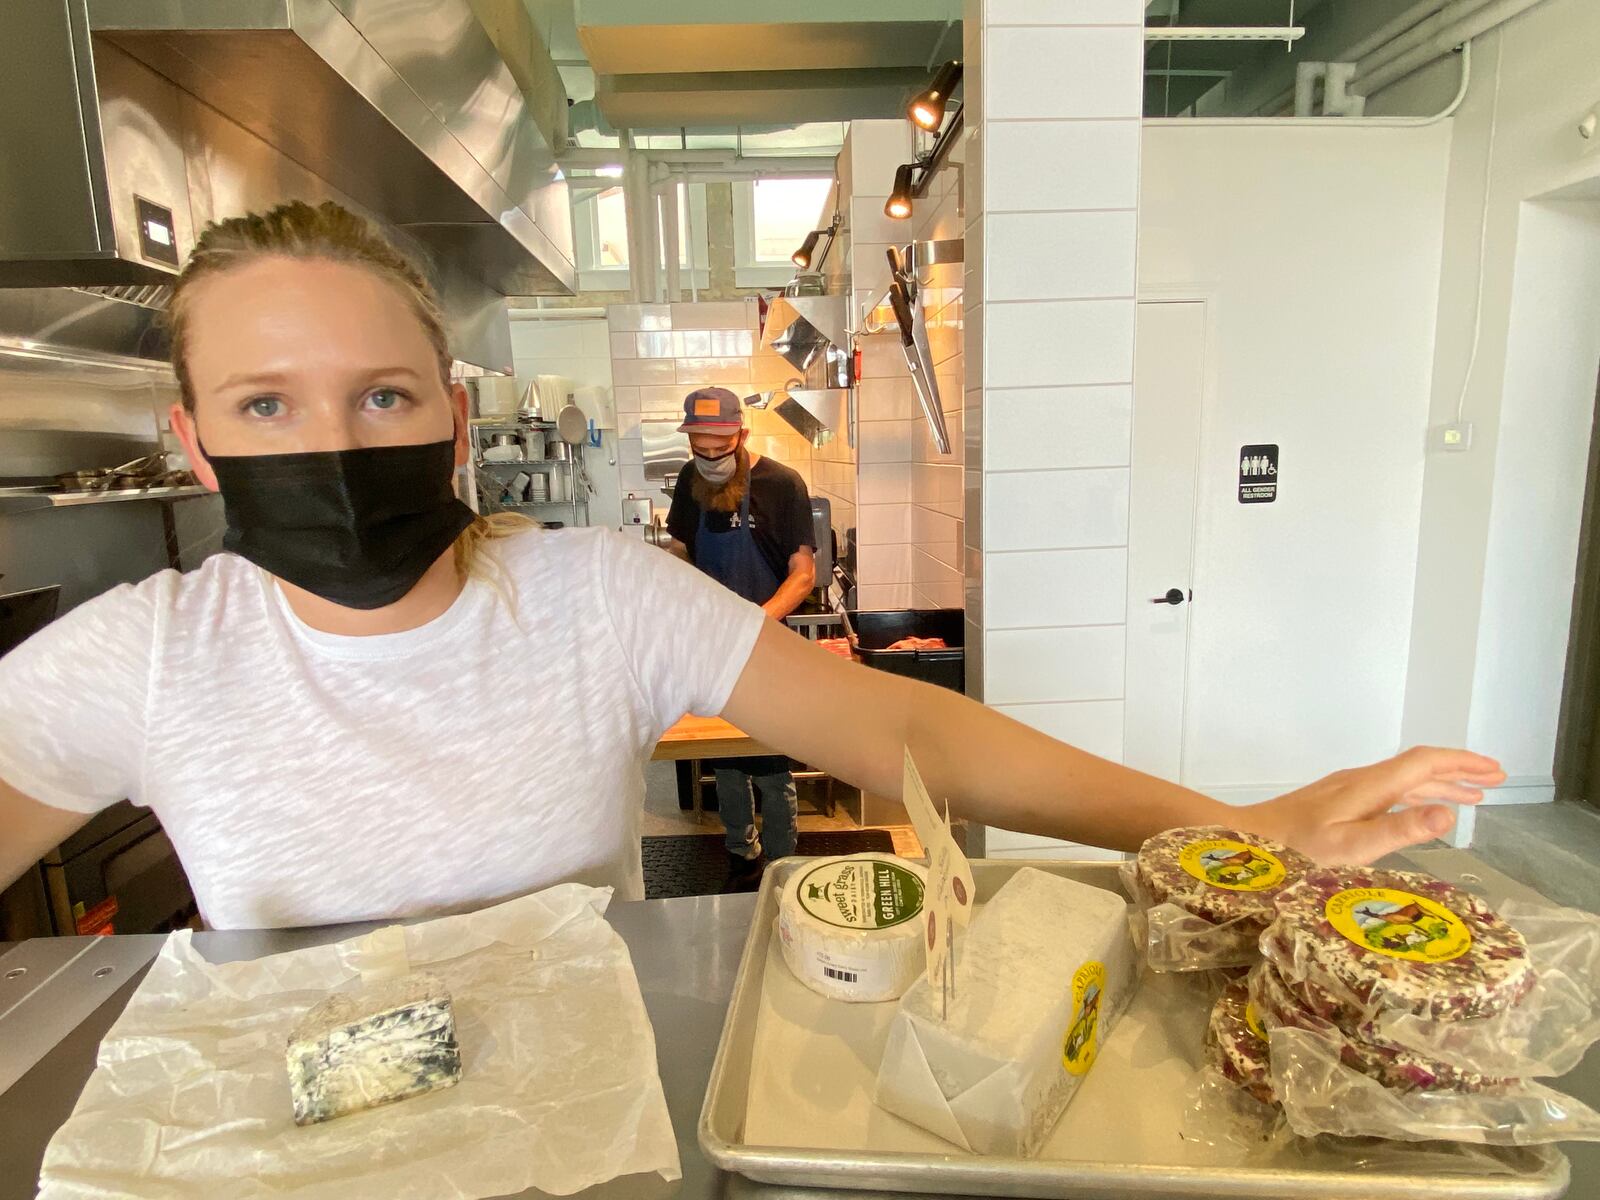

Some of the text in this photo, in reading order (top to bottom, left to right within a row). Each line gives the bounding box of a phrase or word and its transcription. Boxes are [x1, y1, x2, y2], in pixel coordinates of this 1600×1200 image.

[833, 865, 857, 922] sweet grass
[879, 869, 895, 920] GREEN HILL
[1331, 890, 1386, 914] CAPRIOLE
